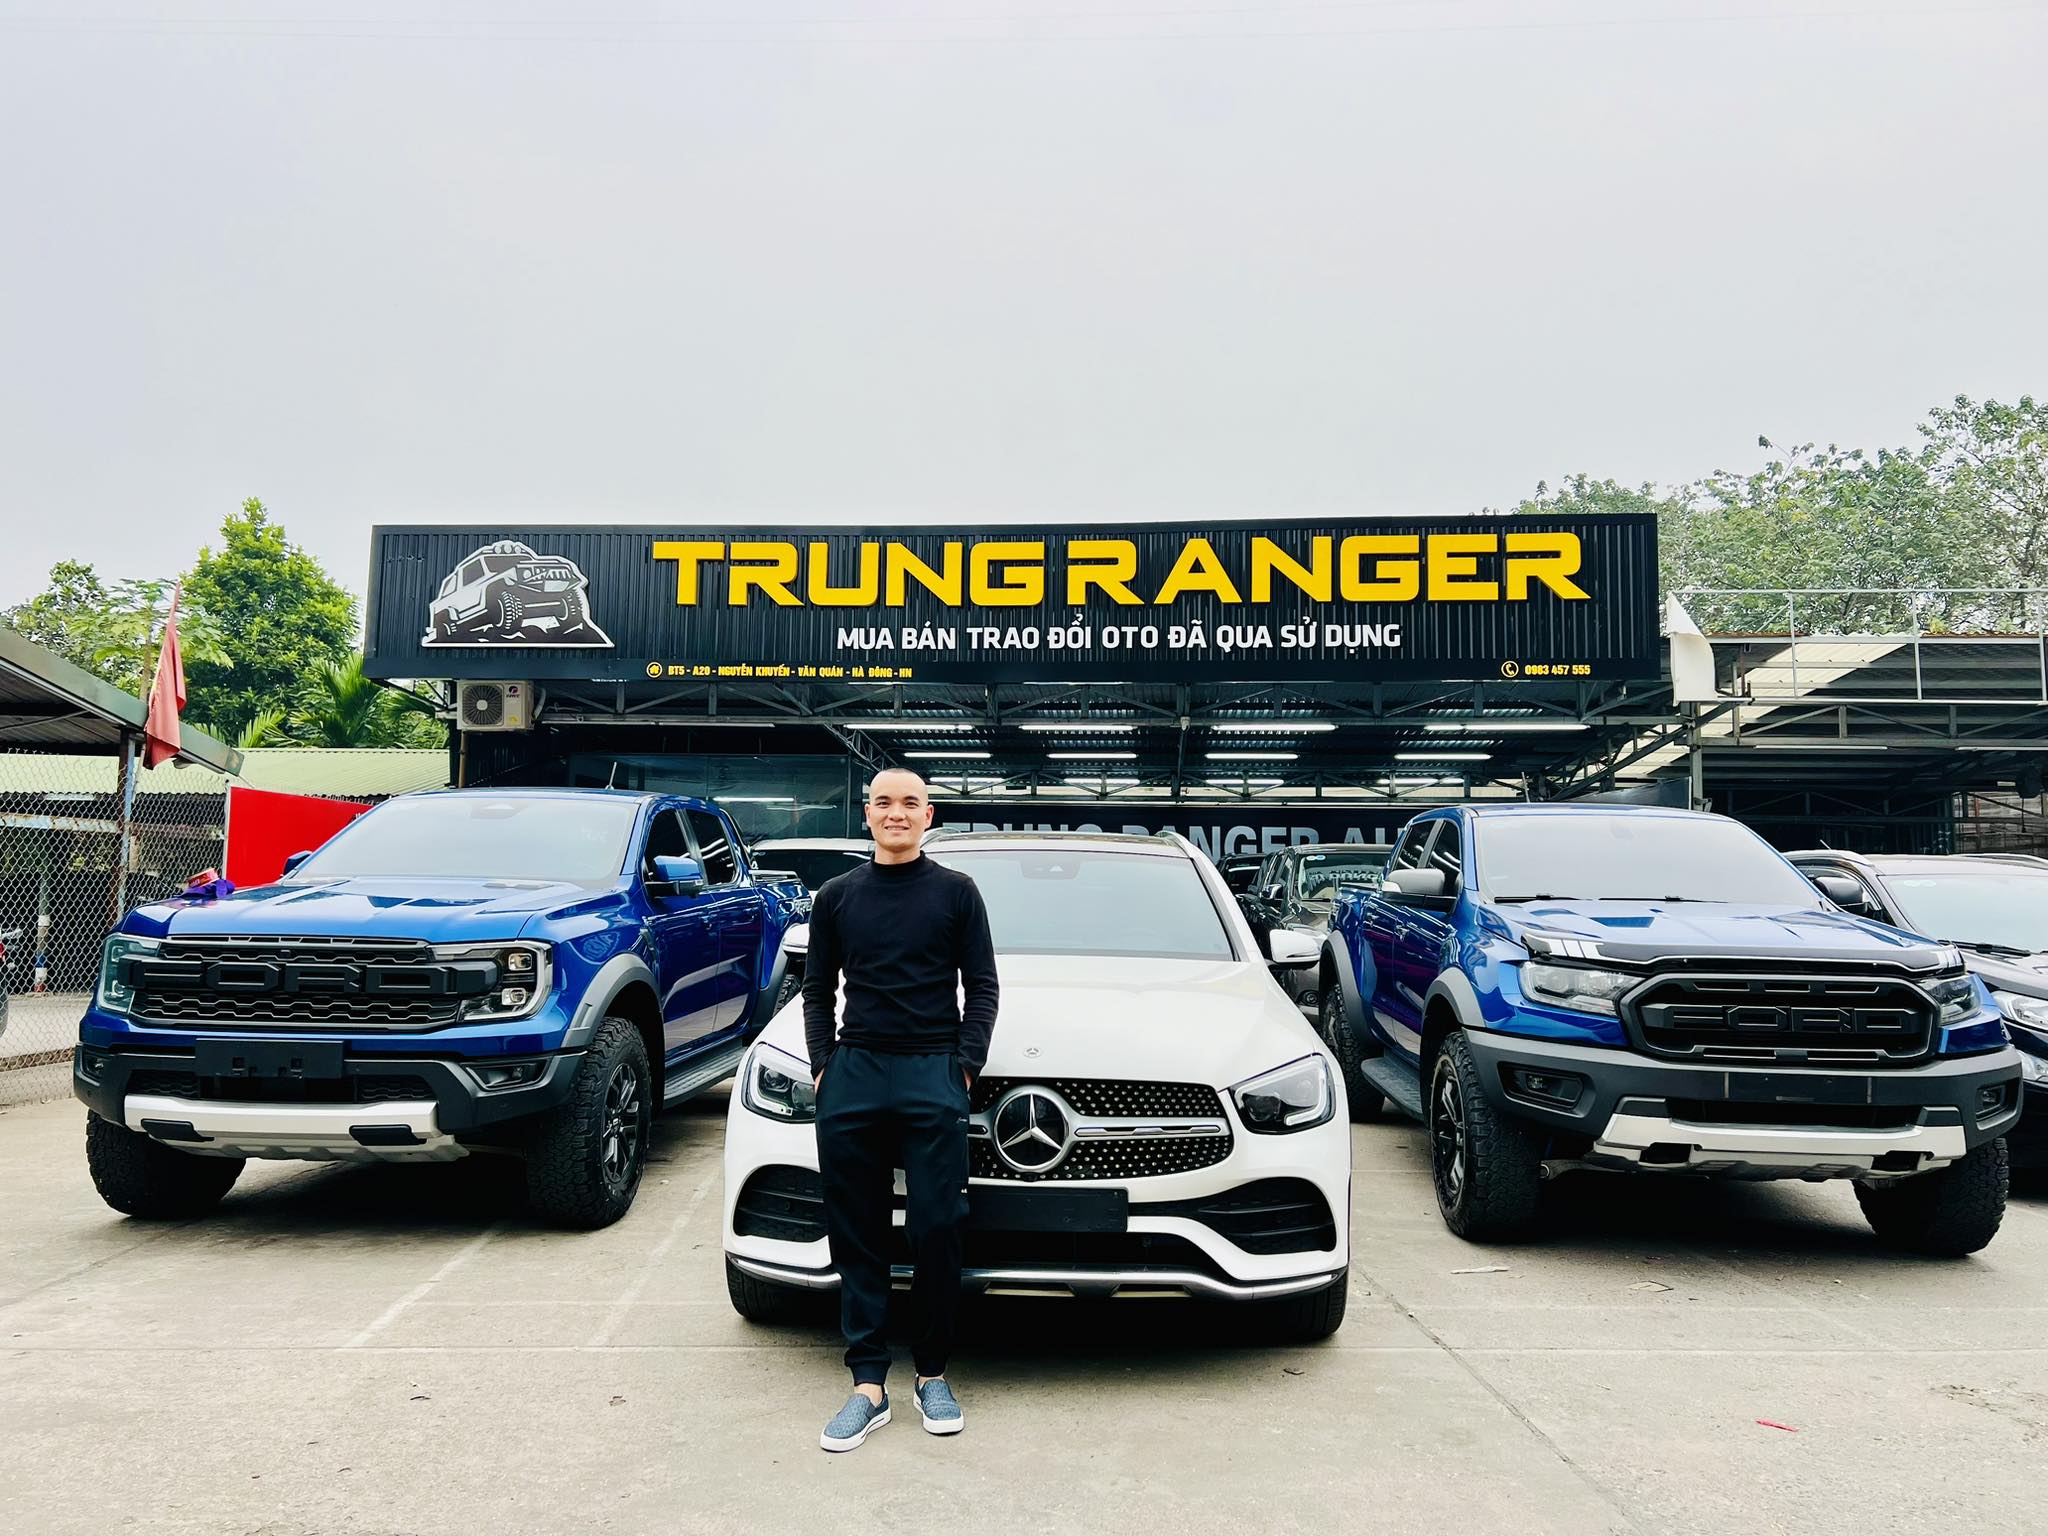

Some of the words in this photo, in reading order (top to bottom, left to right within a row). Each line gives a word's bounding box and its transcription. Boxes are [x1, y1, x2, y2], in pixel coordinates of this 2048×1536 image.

[652, 541, 1045, 607] TRUNG
[1067, 532, 1590, 605] RANGER
[837, 627, 895, 650] MUA
[901, 620, 956, 650] BÁN
[966, 626, 1040, 649] TRAO
[1047, 613, 1092, 649] ĐỔI
[1101, 625, 1159, 649] OTO
[1167, 619, 1207, 648] ĐÃ
[1216, 625, 1273, 653] QUA
[1280, 616, 1317, 648] SỬ
[1325, 624, 1401, 654] DỤNG
[668, 665, 685, 676] BT5
[692, 665, 711, 676] A20
[898, 667, 913, 678] HN
[1524, 664, 1550, 675] 0983
[1551, 664, 1570, 675] 457
[1572, 664, 1591, 675] 555
[132, 959, 448, 995] FORD
[1664, 1004, 1918, 1034] FORD
